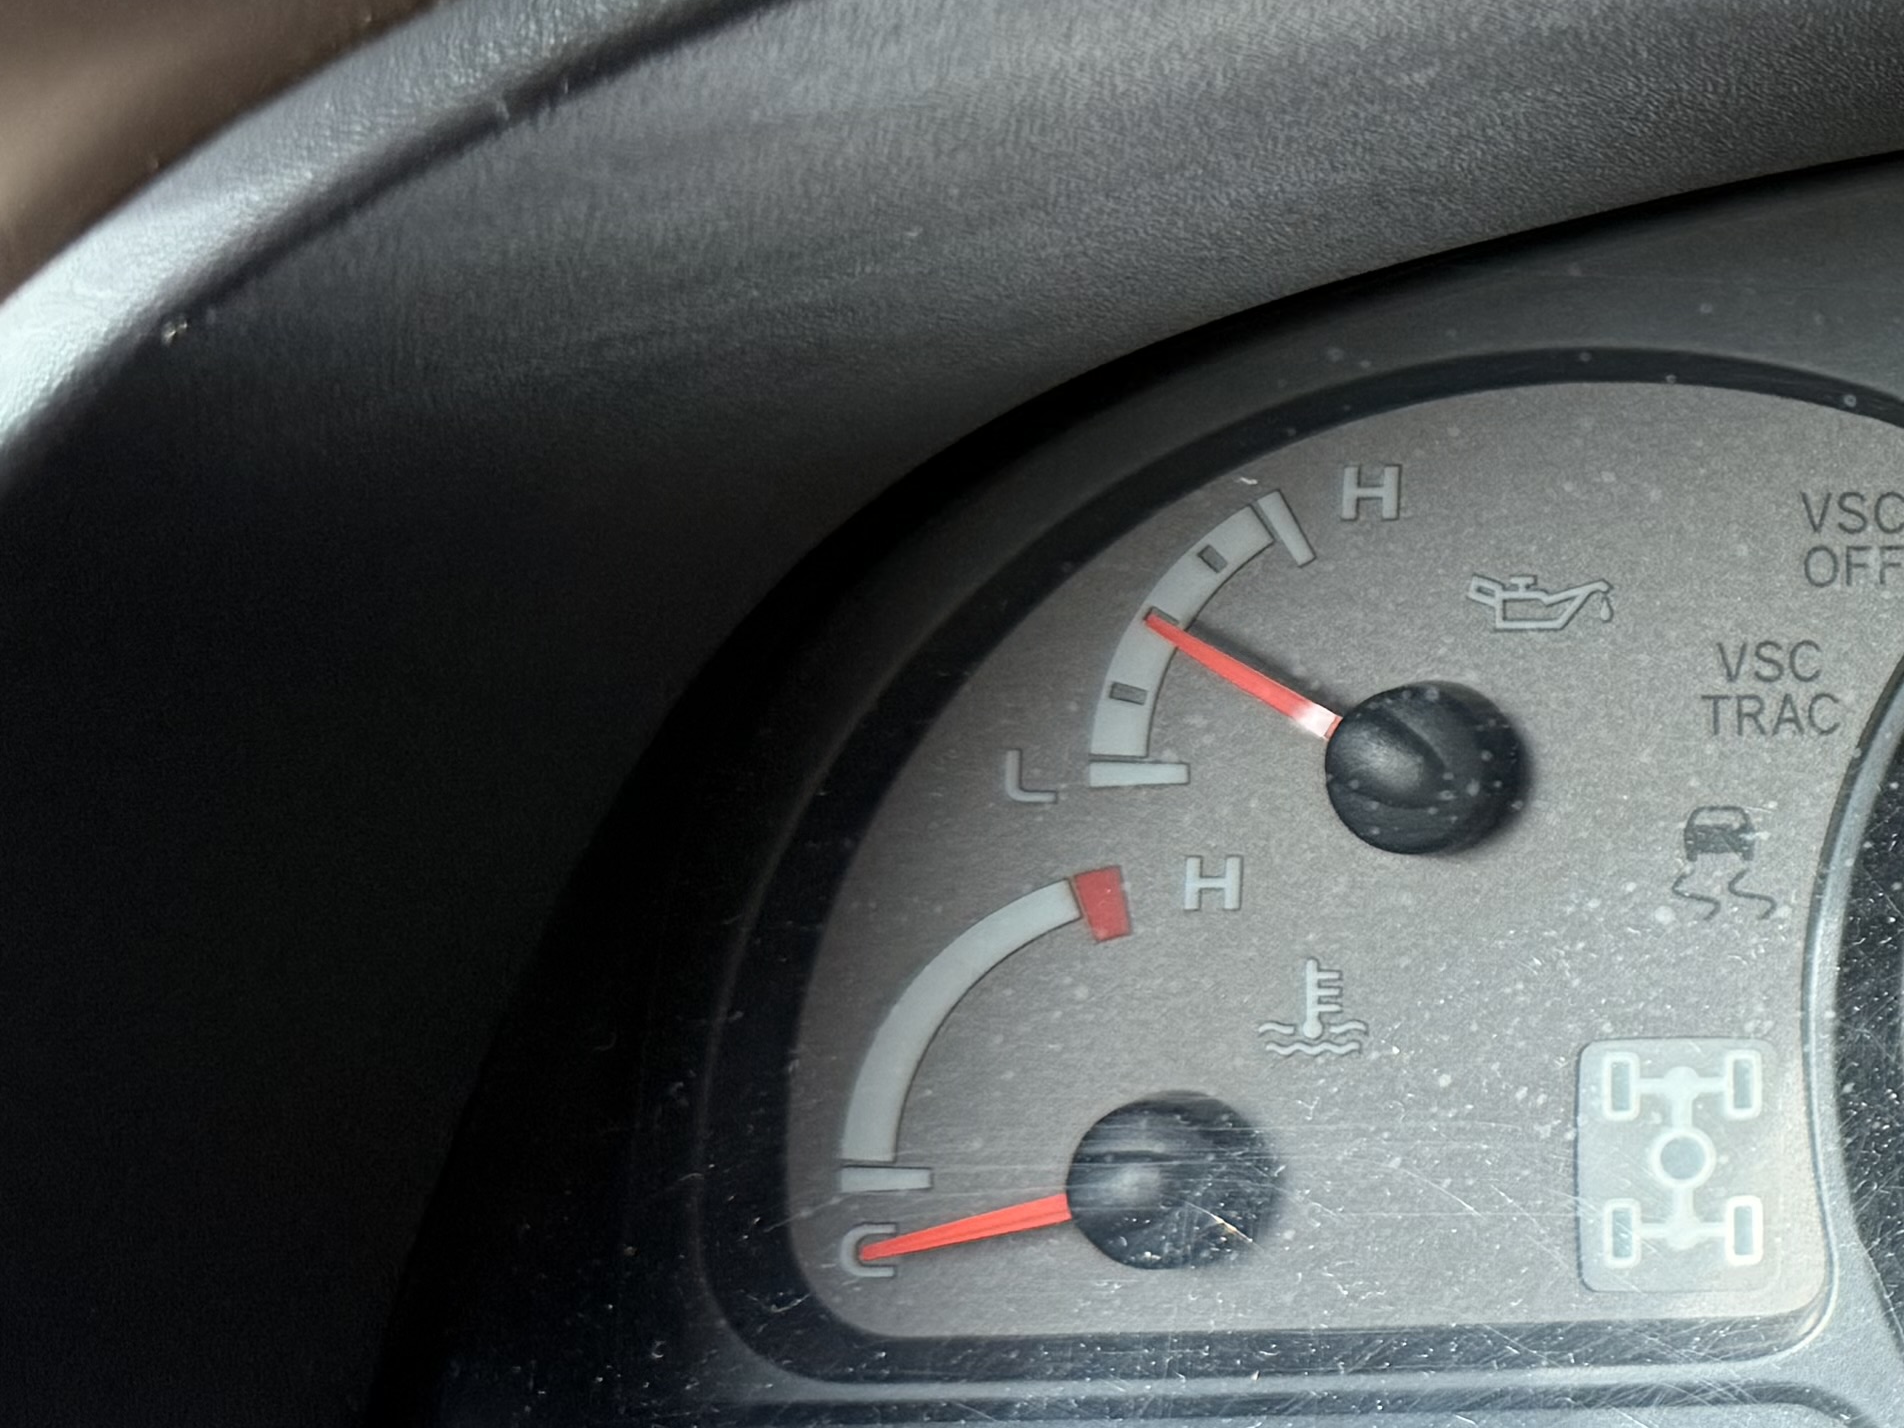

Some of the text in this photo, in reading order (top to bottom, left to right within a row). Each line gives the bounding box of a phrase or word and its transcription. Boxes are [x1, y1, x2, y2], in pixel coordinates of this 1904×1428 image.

[1341, 464, 1401, 521] H
[1717, 640, 1822, 683] VSC
[1702, 693, 1841, 736] TRAC
[1006, 748, 1059, 804] L
[1184, 855, 1243, 911] H
[840, 1223, 896, 1278] C
